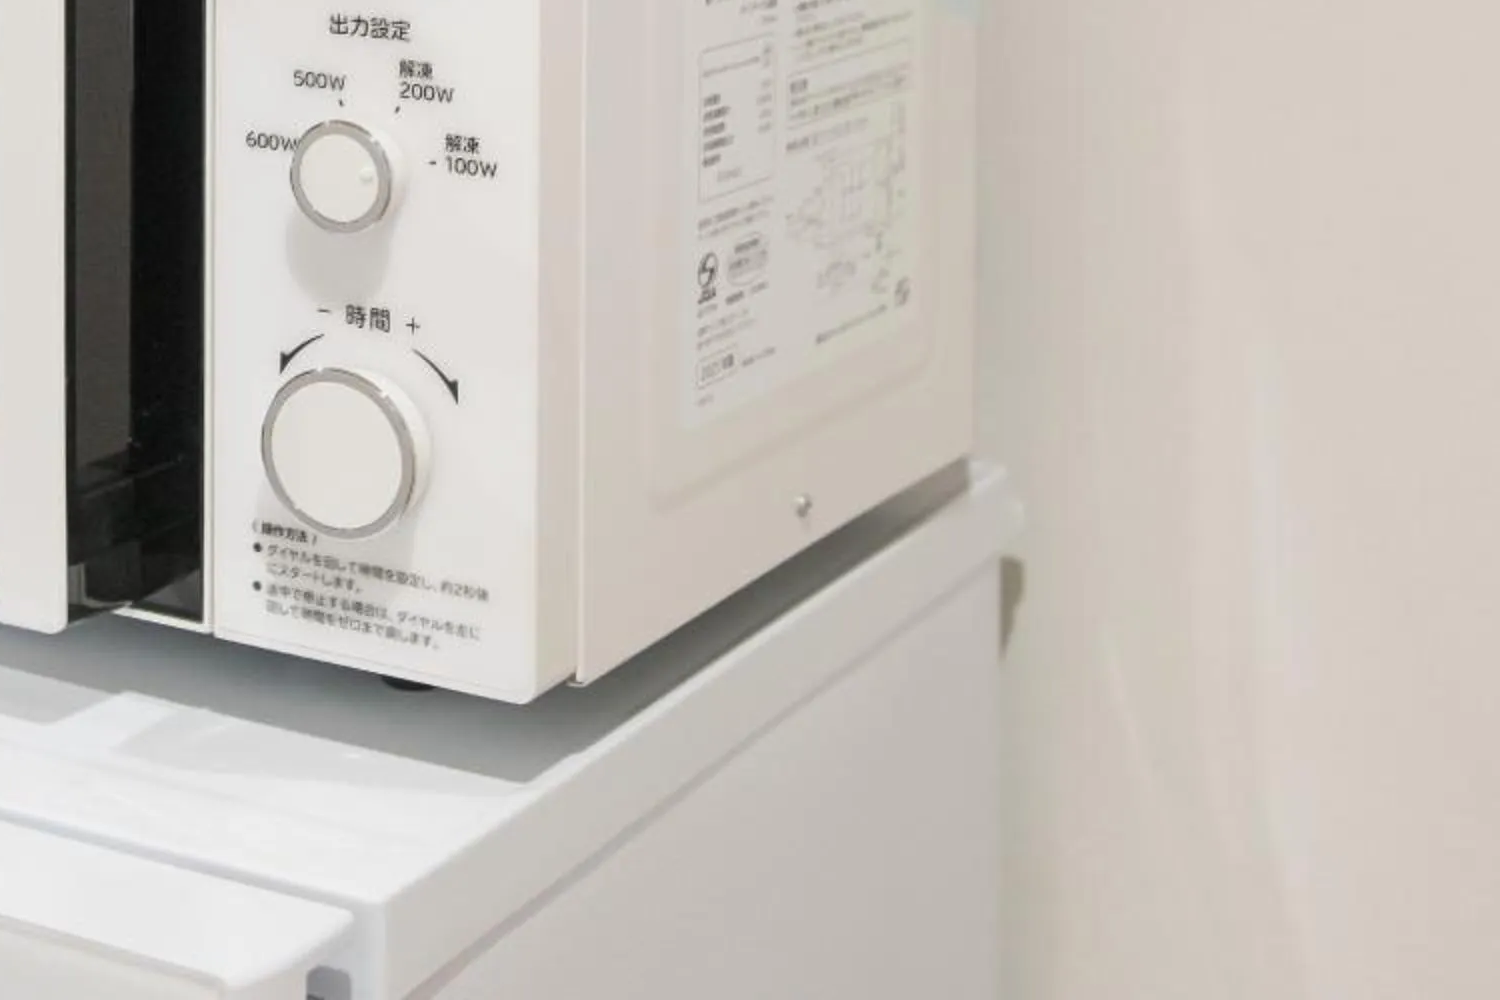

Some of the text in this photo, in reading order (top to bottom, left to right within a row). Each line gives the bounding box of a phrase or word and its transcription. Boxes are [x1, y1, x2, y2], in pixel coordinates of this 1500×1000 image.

[329, 13, 411, 42] 出力設定
[399, 59, 434, 80] 解凍
[293, 70, 347, 92] 500W
[399, 81, 455, 104] 200W
[246, 130, 298, 152] 600W
[445, 134, 480, 154] 解凍
[446, 155, 498, 178] 100W
[345, 304, 391, 333] 時間
